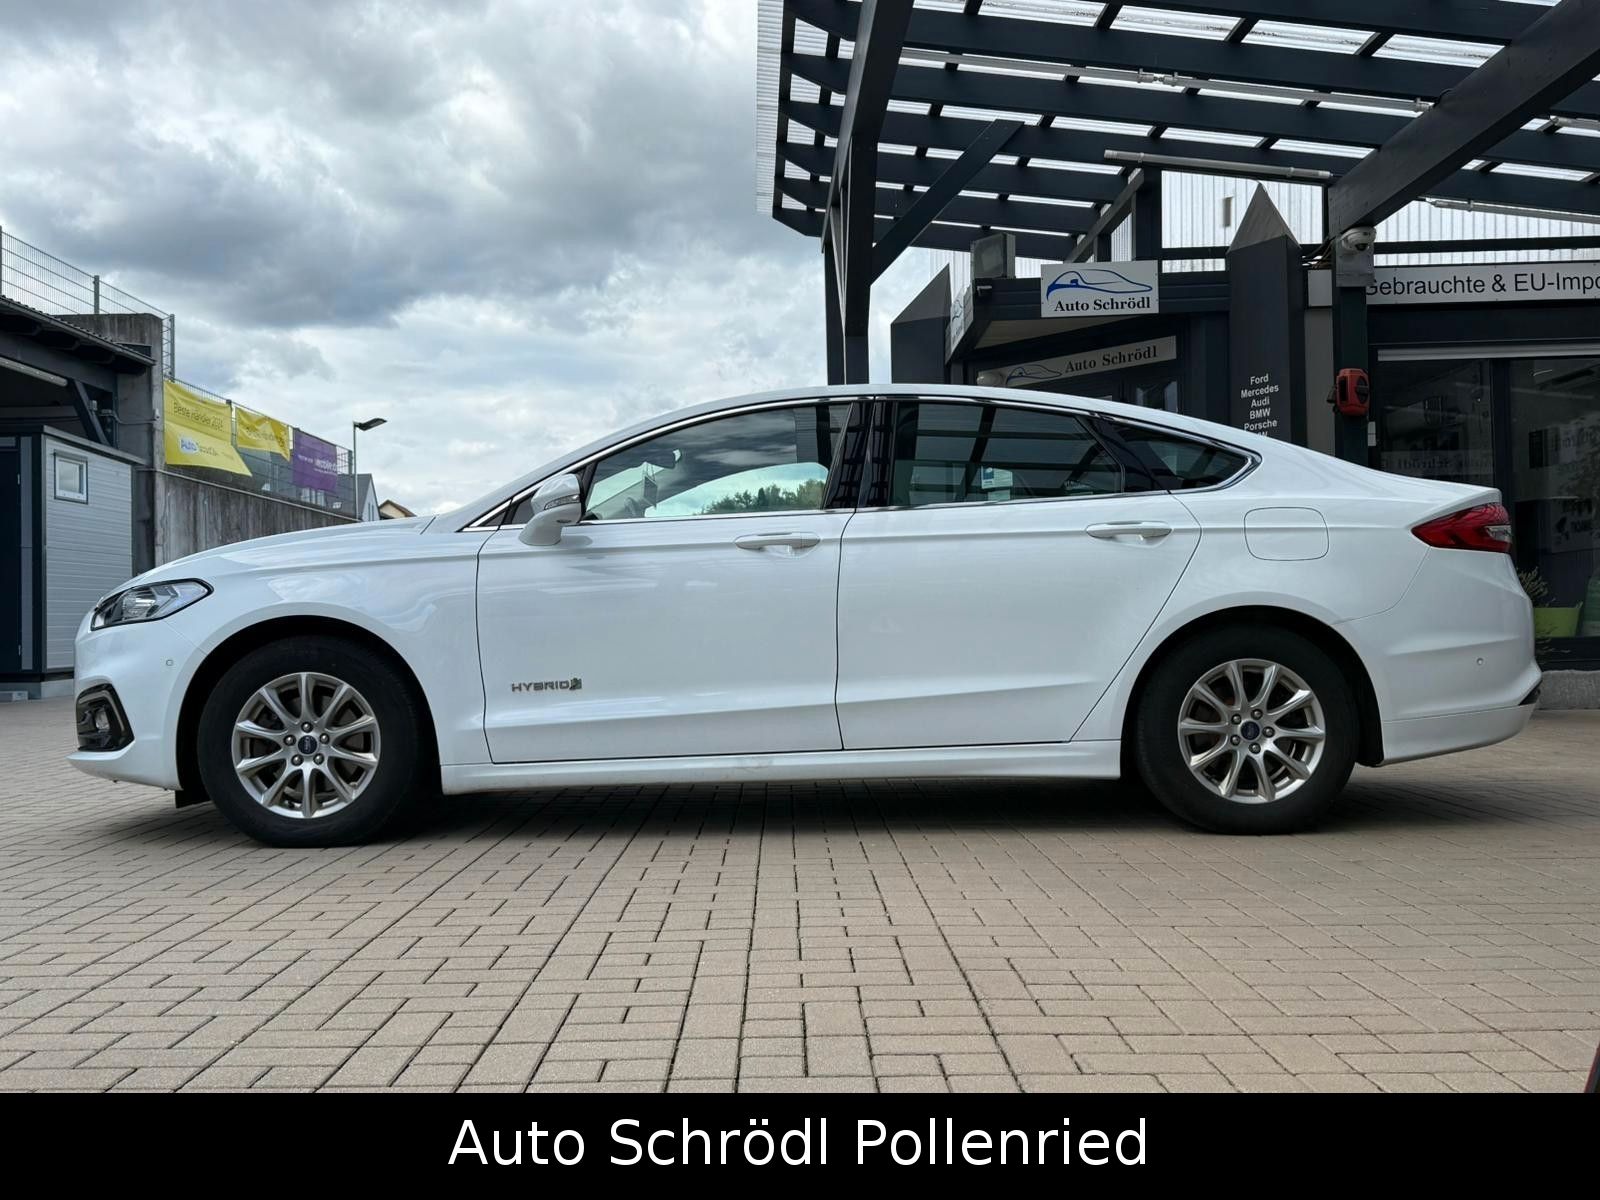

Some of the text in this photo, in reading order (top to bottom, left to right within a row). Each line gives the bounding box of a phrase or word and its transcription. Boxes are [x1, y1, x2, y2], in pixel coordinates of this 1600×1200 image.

[1491, 273, 1506, 293] &
[1054, 296, 1151, 312] Auto Schrödl
[1064, 345, 1158, 374] Auto Schrödl
[1250, 373, 1269, 386] Ford
[1240, 384, 1280, 399] Mercedes
[1250, 395, 1270, 409] Audi
[1249, 407, 1271, 420] BMW
[1243, 418, 1278, 431] Porsche
[511, 680, 570, 692] HYBRID
